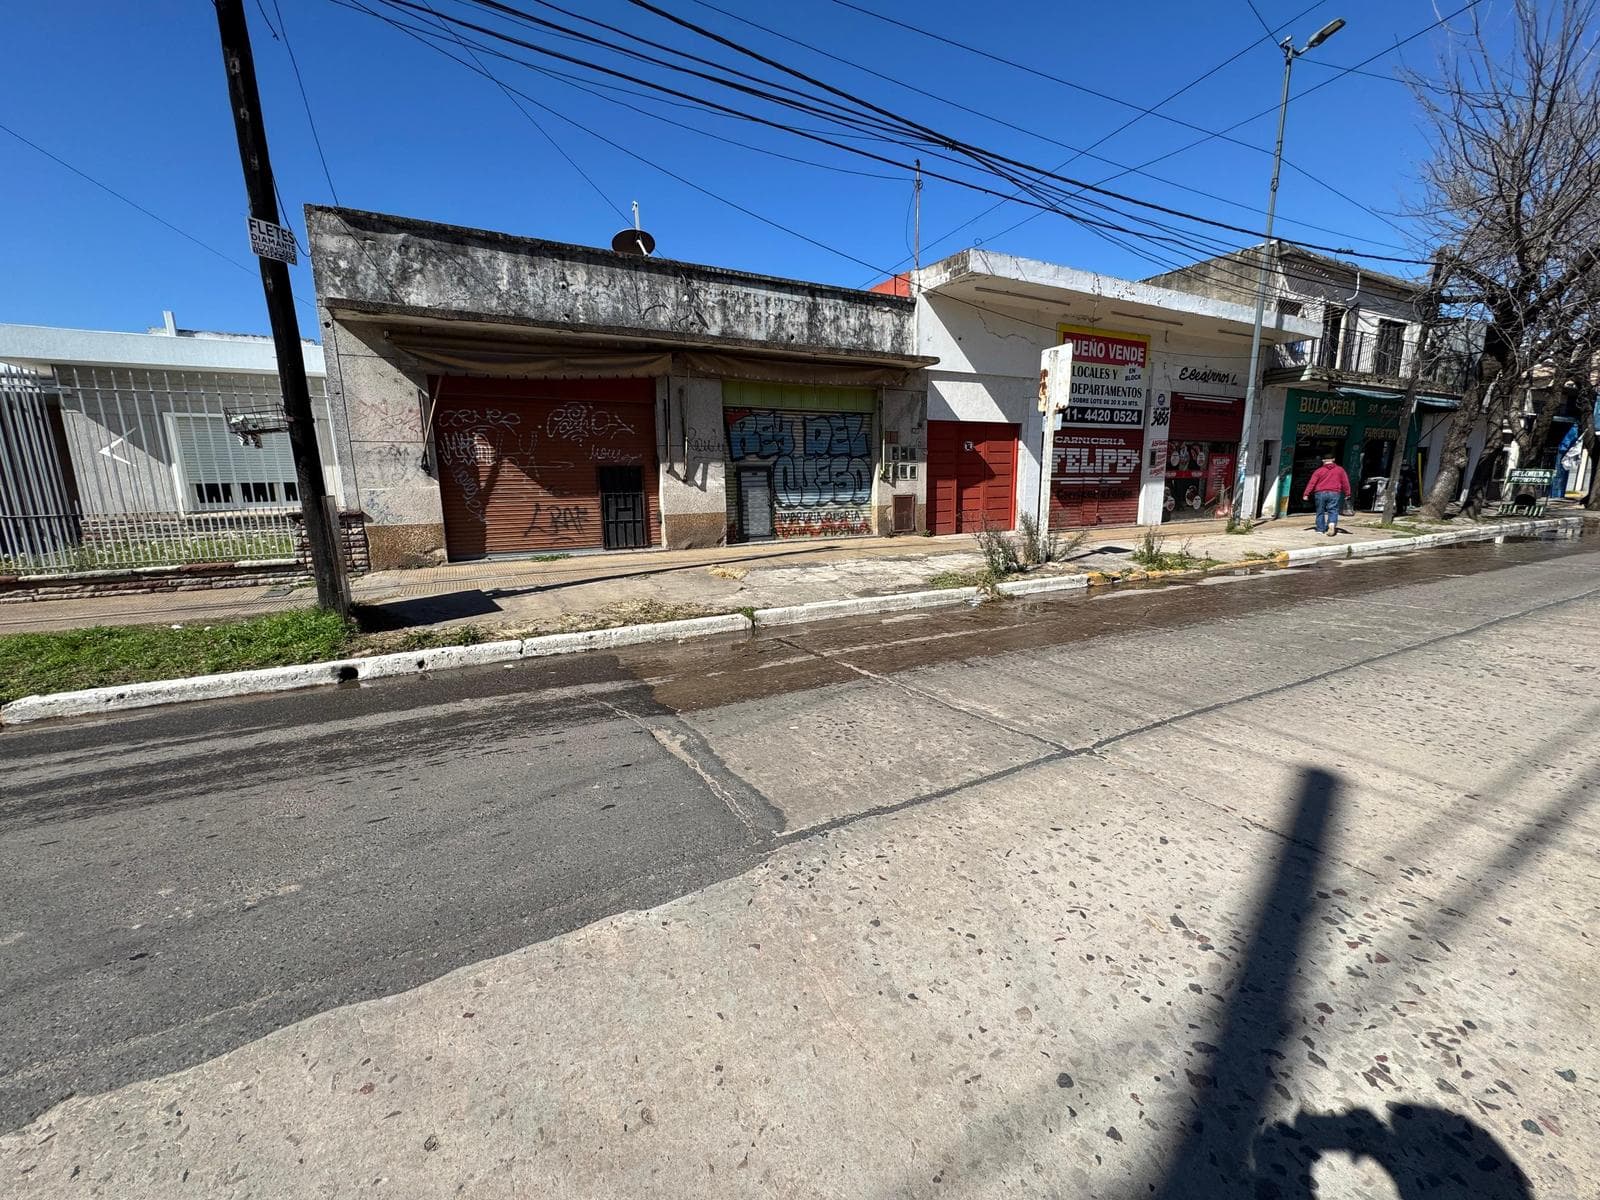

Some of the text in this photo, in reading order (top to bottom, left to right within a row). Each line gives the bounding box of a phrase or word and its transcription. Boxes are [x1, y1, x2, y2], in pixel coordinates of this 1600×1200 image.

[249, 219, 295, 244] FLETES
[1109, 343, 1145, 363] VENDE
[1072, 365, 1119, 380] LOCALES Y
[1071, 382, 1143, 398] DEPARTAMENTOS
[1085, 408, 1111, 421] 4420
[1113, 410, 1138, 423] 0524
[1299, 396, 1356, 416] BULONERA
[731, 414, 795, 461] REY
[803, 414, 870, 457] DEL
[1054, 435, 1126, 446] CARNICERIA
[1051, 448, 1132, 473] FELIPE
[773, 456, 873, 507] QUESO
